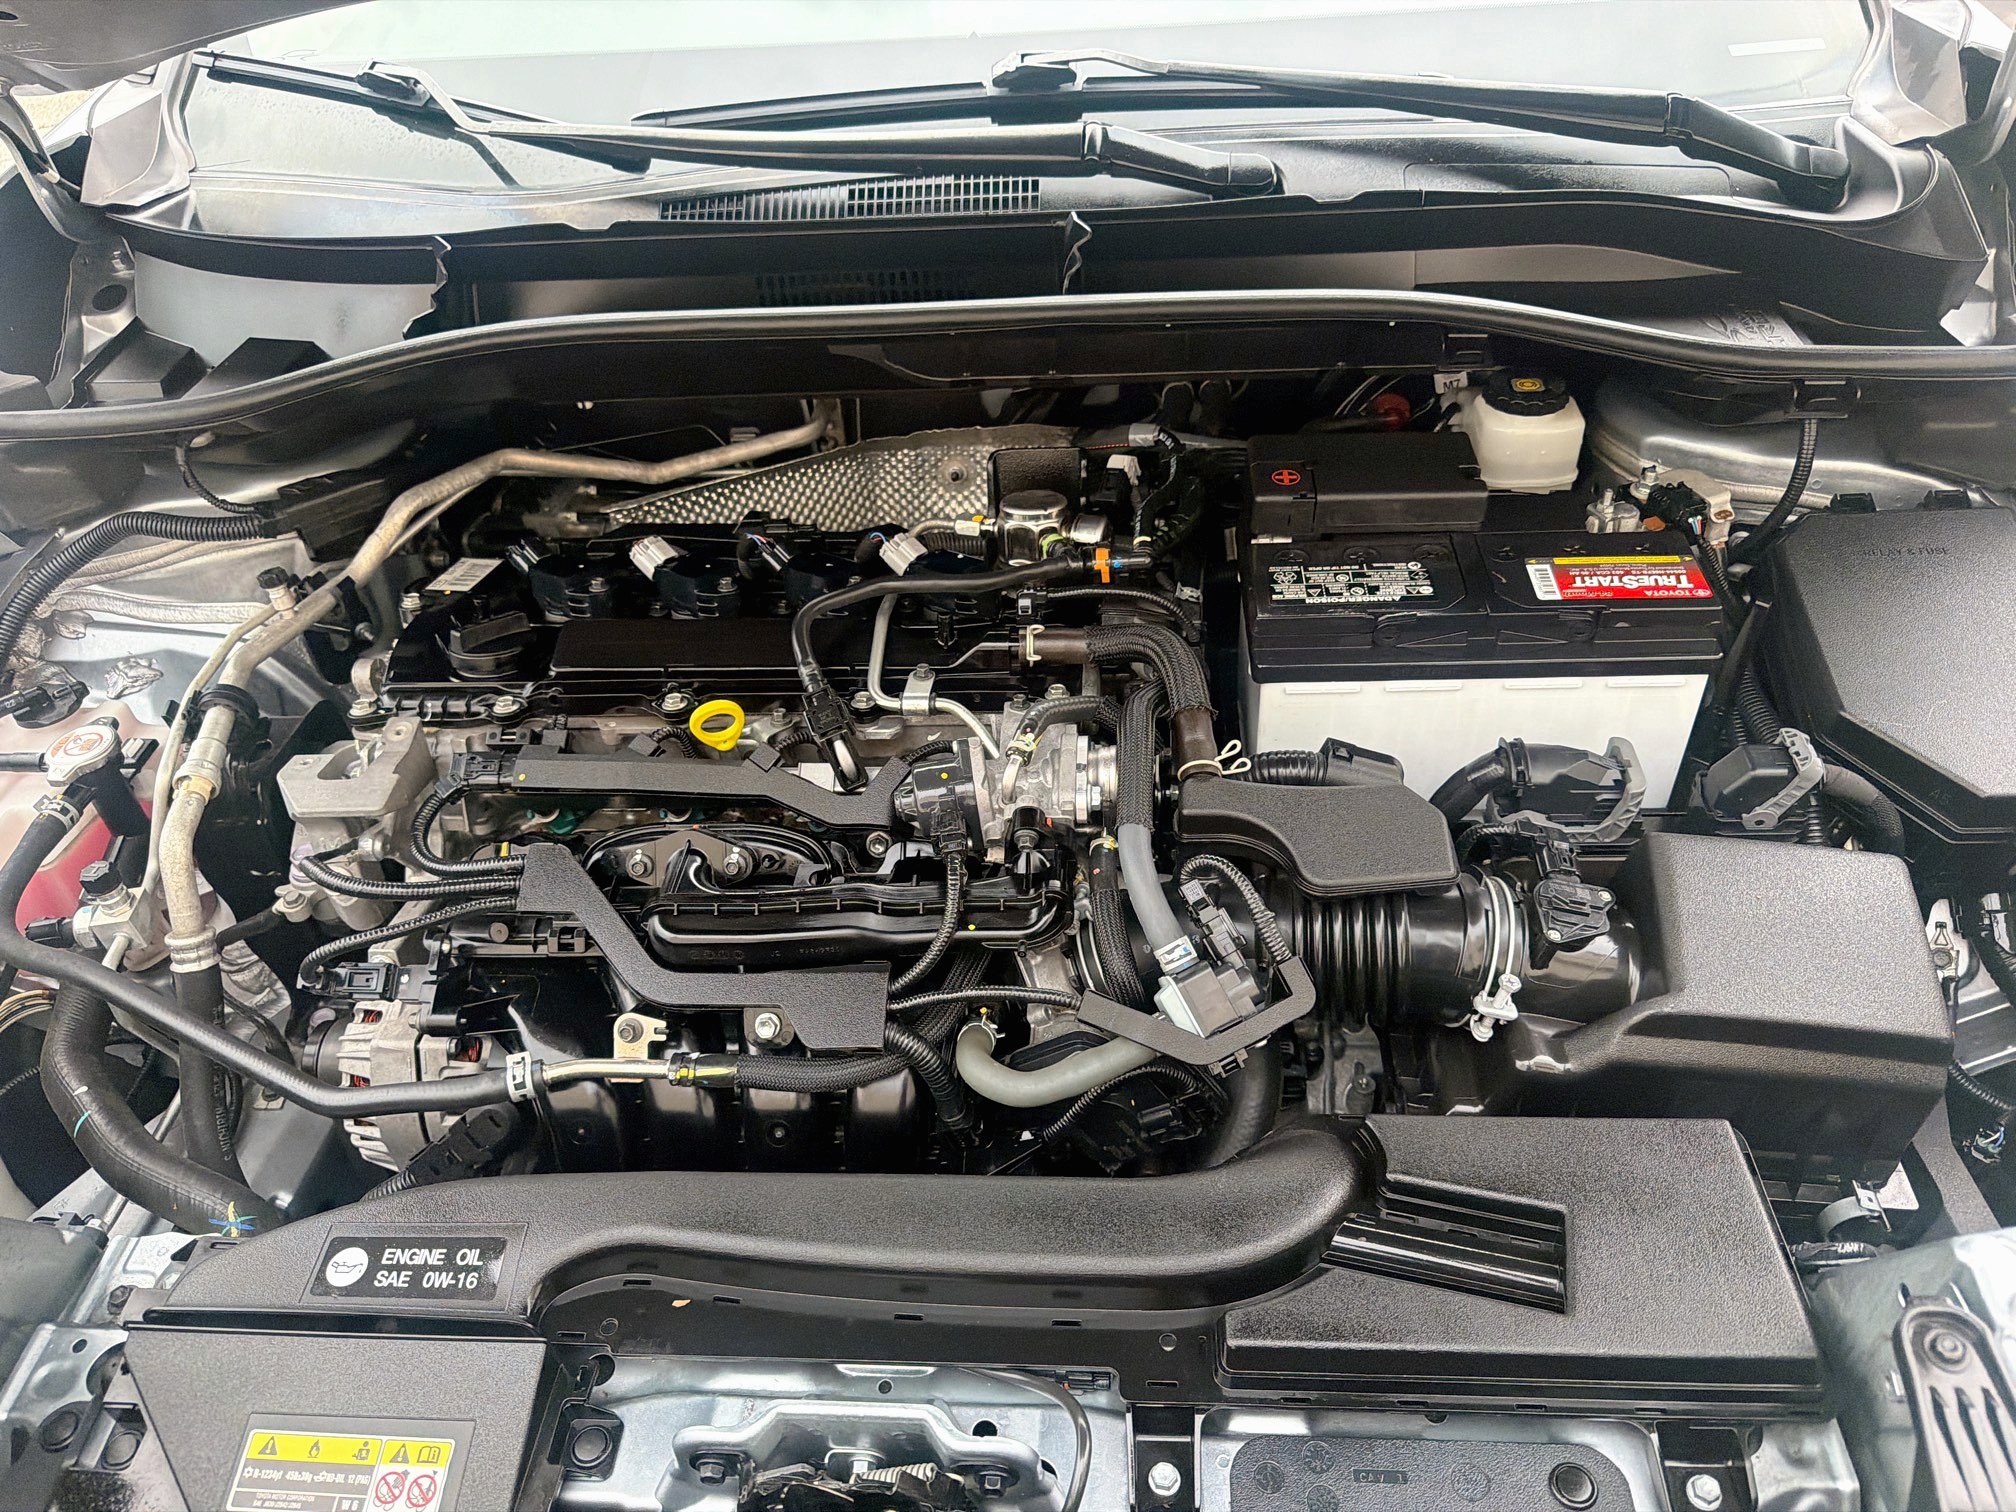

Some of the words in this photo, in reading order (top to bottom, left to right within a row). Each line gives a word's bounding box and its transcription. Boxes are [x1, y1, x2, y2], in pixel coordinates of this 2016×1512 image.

[1863, 547, 1902, 556] RELAY
[1919, 547, 1948, 555] FUSE
[381, 1248, 447, 1265] ENGINE
[456, 1248, 484, 1266] OIL
[374, 1270, 412, 1288] SAE
[422, 1272, 479, 1289] 0W-16
[342, 1500, 352, 1510] W
